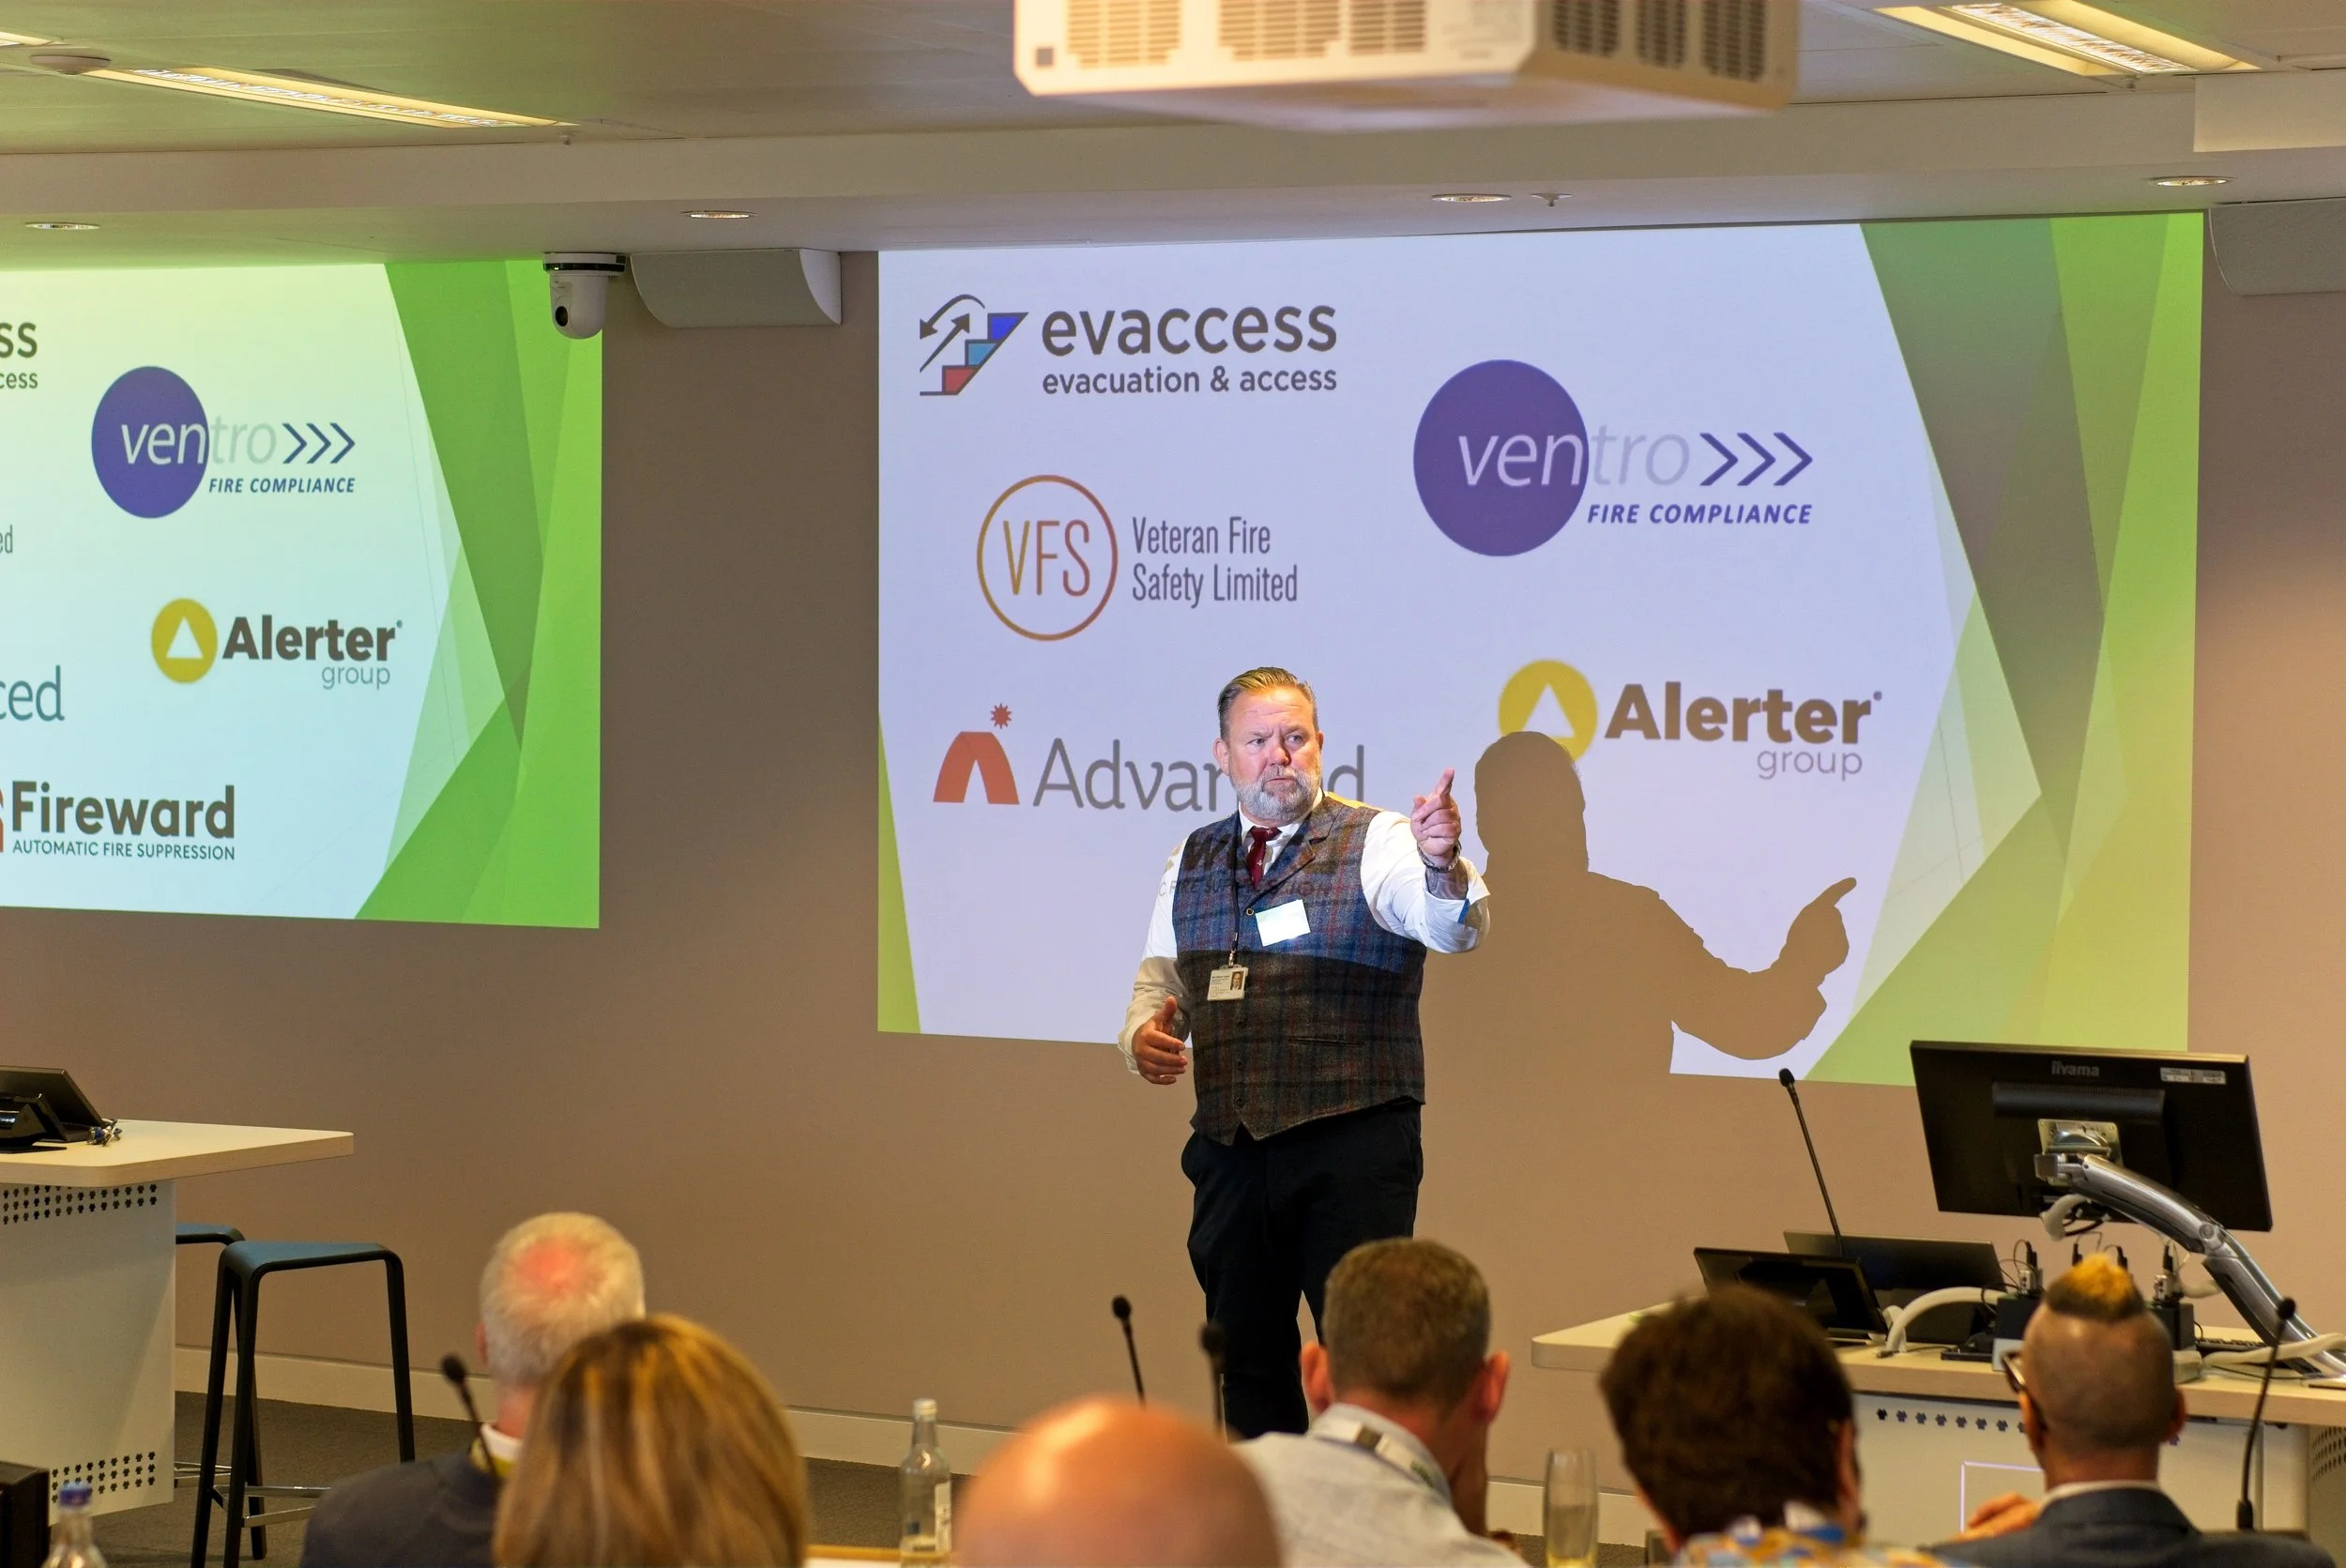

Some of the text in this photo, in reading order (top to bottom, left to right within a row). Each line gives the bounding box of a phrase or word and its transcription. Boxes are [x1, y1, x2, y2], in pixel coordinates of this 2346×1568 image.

[1042, 305, 1337, 357] evaccess
[1043, 365, 1337, 395] evacuation & access
[120, 416, 278, 465] ventro
[1458, 424, 1690, 487] ventro
[208, 478, 356, 494] FIRE COMPLIANCE
[1132, 516, 1271, 555] Veteran Fire
[1587, 504, 1812, 525] FIRE COMPLIANCE
[1002, 519, 1090, 597] VFS
[1132, 562, 1298, 609] Safety Limited
[221, 614, 396, 662] Alerter
[321, 666, 391, 691] group
[1604, 681, 1872, 745] Alerter
[1032, 737, 1364, 813] Advad
[1757, 750, 1864, 782] group
[12, 780, 235, 839] Fireward
[12, 840, 235, 860] AUTOMATIC FIRE SUPPRESSION
